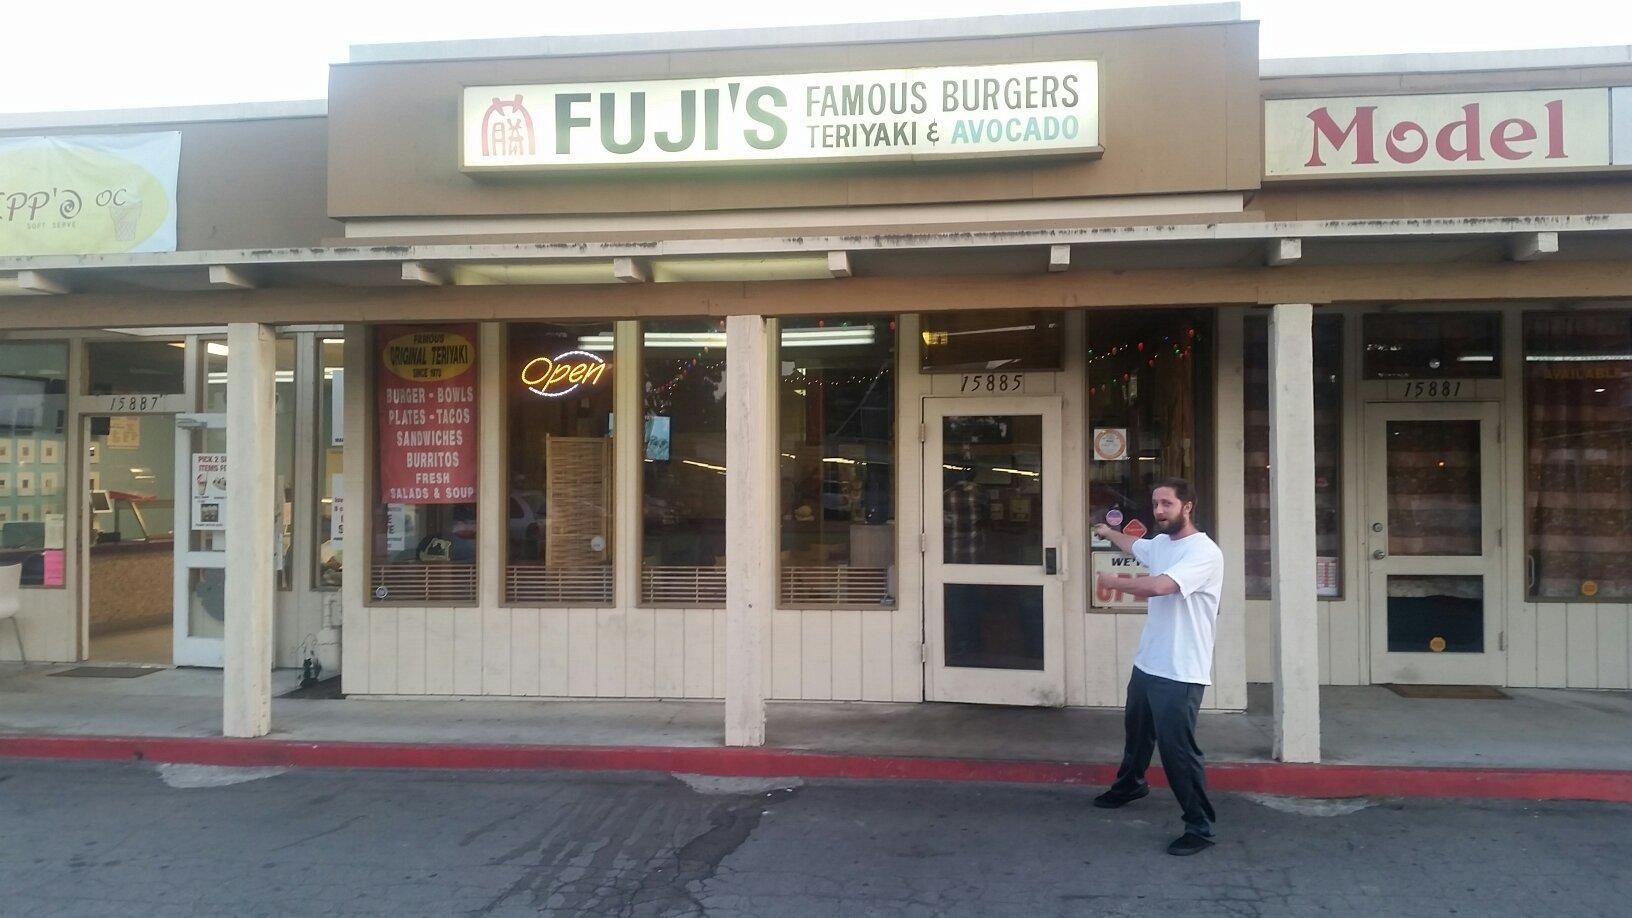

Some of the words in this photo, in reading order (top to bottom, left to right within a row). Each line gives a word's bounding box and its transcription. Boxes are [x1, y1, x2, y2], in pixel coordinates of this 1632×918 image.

[806, 81, 928, 117] FAMOUS
[942, 74, 1079, 113] BURGERS
[555, 83, 788, 155] FUJI'S
[807, 122, 917, 148] TERIYAKI
[926, 119, 940, 146] &
[951, 115, 1079, 145] AVOCADO
[1304, 99, 1569, 167] Model
[27, 222, 46, 230] SOFT
[52, 221, 76, 229] SERVE
[413, 334, 445, 344] FAMOUS
[390, 346, 426, 366] ORIGINAL
[431, 344, 469, 365] TERIYAKI
[521, 357, 606, 392] Open
[960, 374, 1023, 392] 15885
[386, 388, 426, 404] BURGER
[437, 386, 474, 403] BOWLS
[1405, 381, 1462, 398] 15881
[110, 397, 158, 411] 15887
[388, 409, 426, 425] PLATES
[436, 408, 470, 424] TACOS
[396, 430, 463, 447] SANDWICHES
[406, 452, 460, 468] BURRITOS
[415, 472, 451, 484] FRESH
[390, 487, 429, 499] SALADS
[433, 488, 440, 499] &
[446, 487, 474, 499] SOUP
